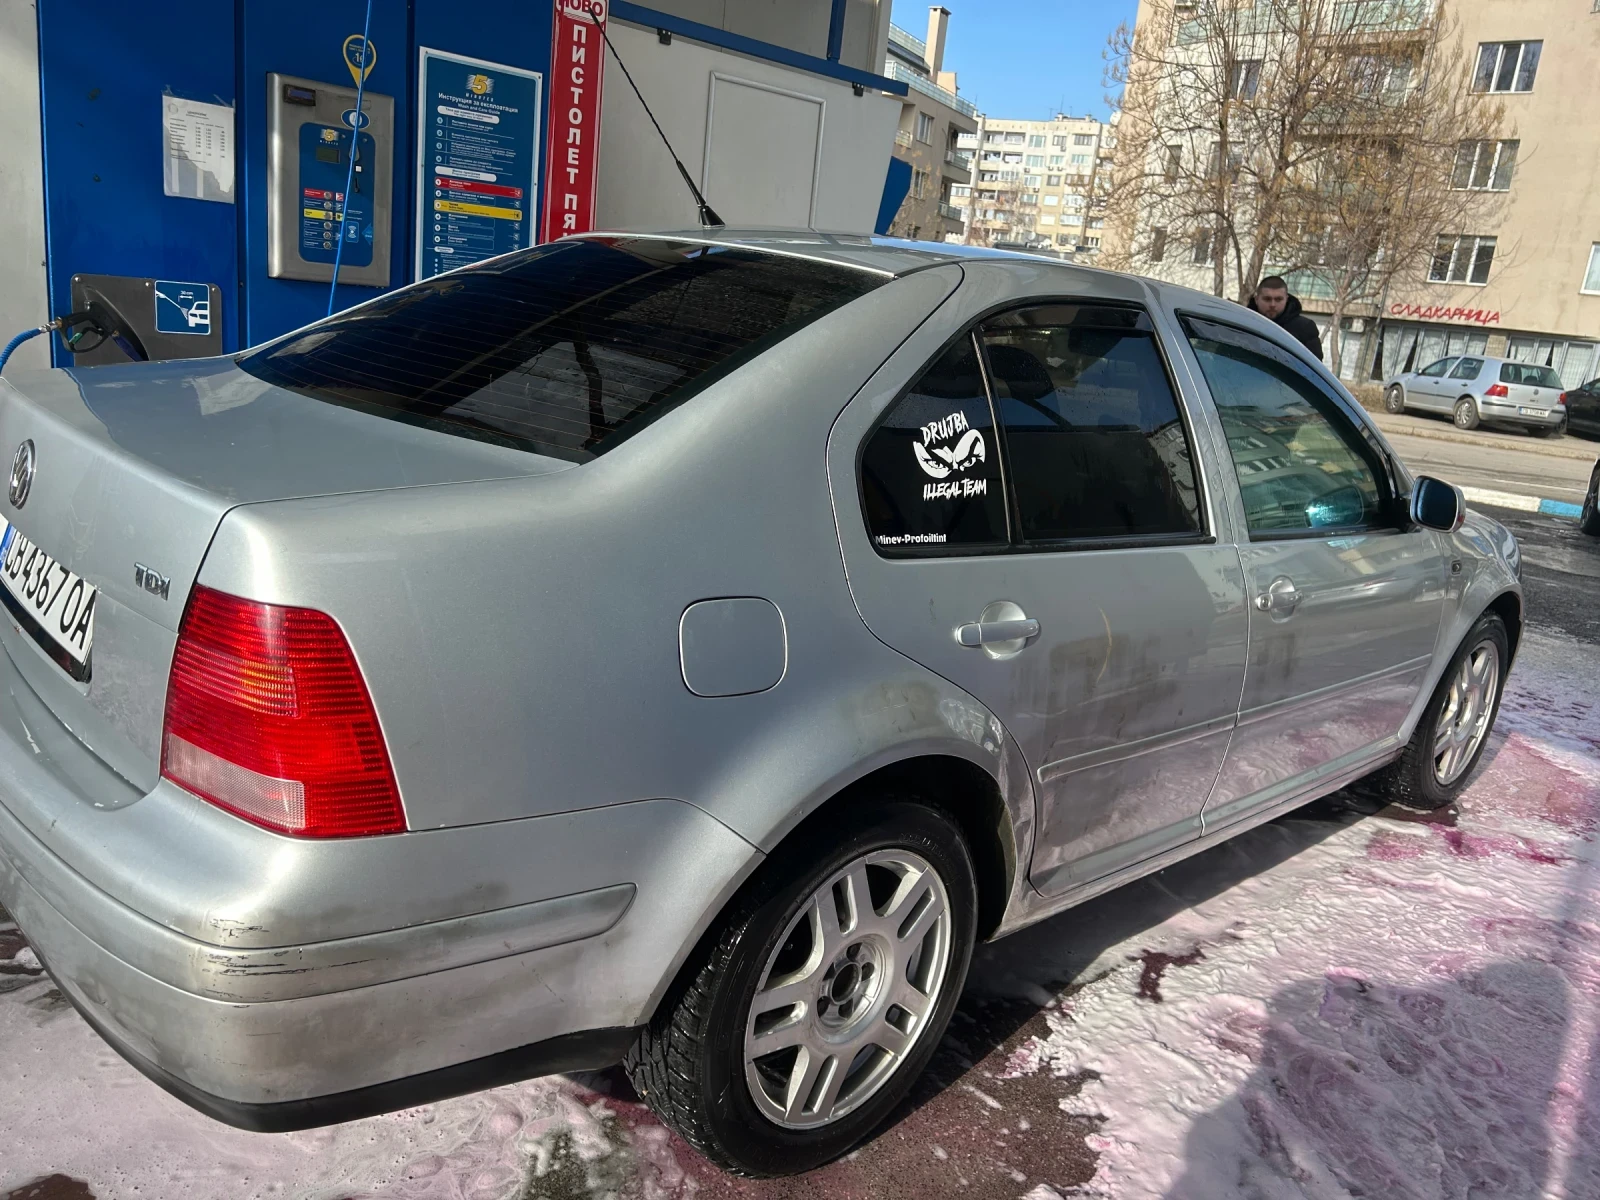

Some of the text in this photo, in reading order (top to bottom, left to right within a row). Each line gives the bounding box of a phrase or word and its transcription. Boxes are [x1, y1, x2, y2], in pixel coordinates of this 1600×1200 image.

[471, 73, 489, 95] 5
[438, 92, 473, 105] Инструкция
[562, 24, 587, 237] ПИСТОЛЕТ ПЯ
[1391, 303, 1500, 325] СЛАДКАРНИЦА
[920, 410, 970, 447] DRUJBA
[922, 478, 987, 501] ILLEGAL TEAM
[133, 562, 171, 601] TDI
